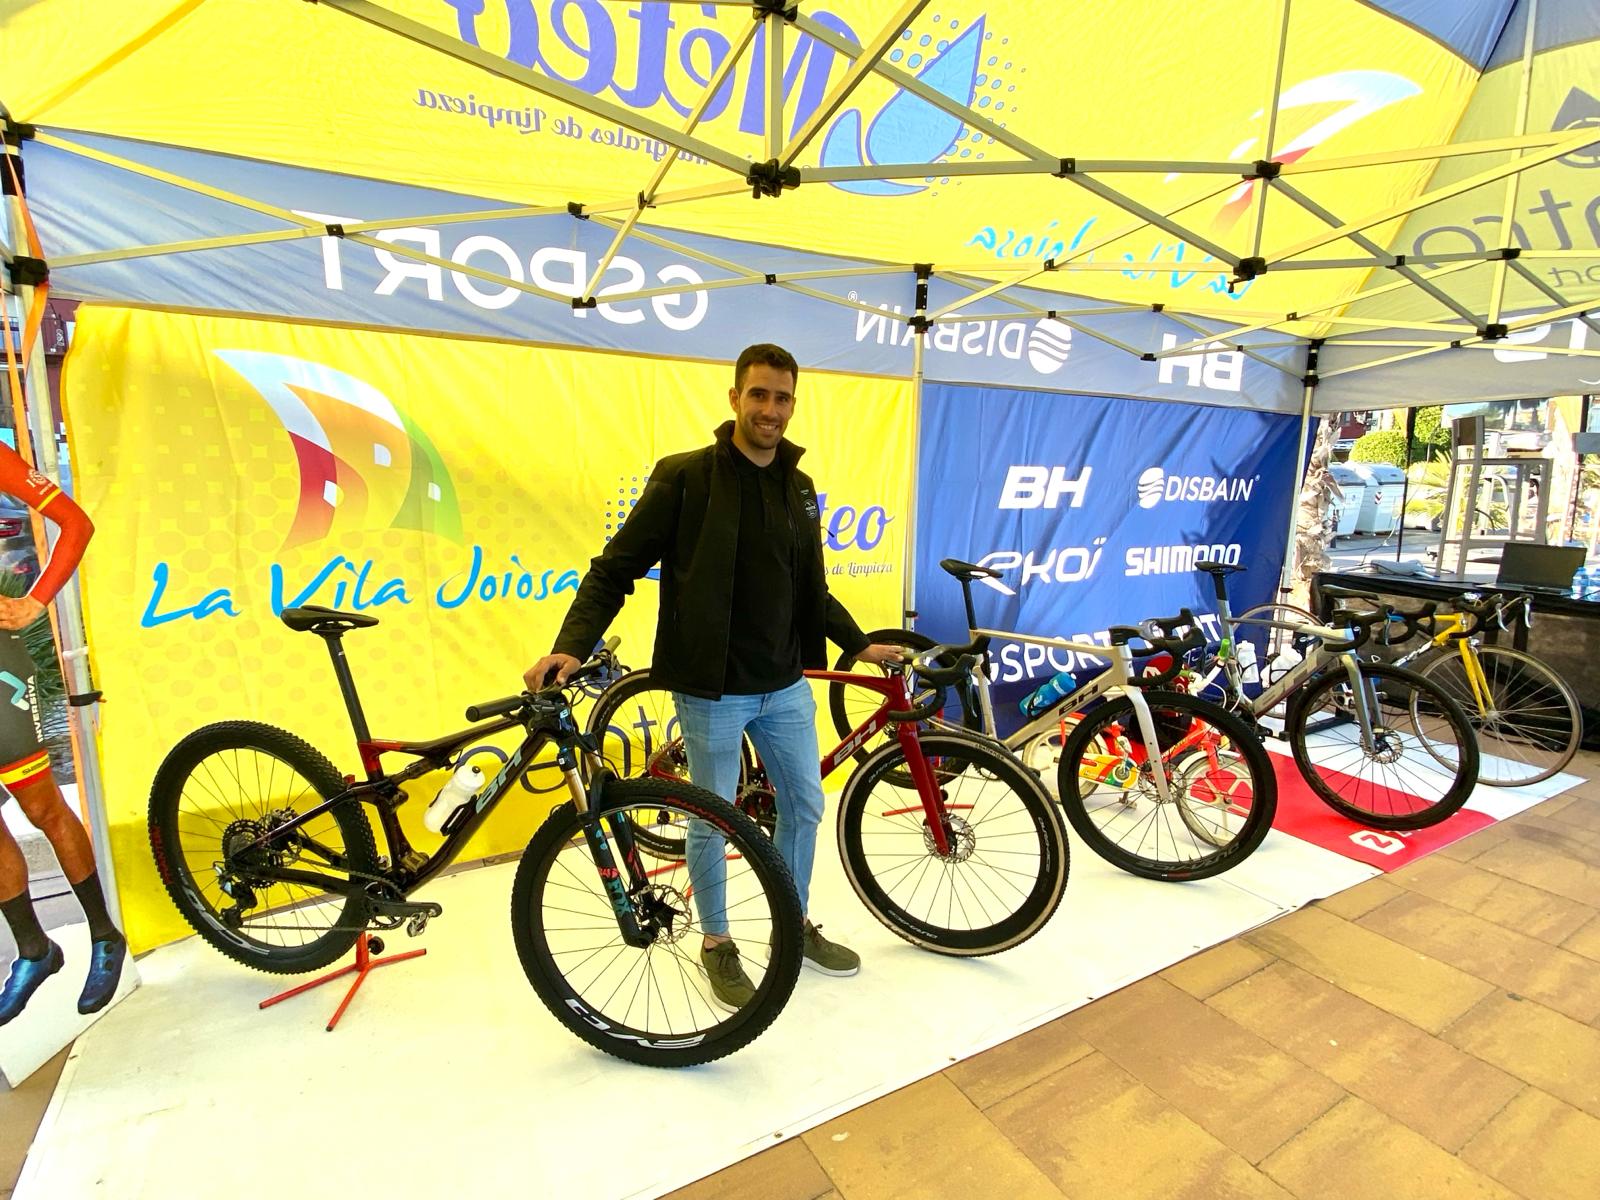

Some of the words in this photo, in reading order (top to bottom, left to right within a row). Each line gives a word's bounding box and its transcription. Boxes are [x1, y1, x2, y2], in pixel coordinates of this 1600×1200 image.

[998, 465, 1092, 510] BH
[141, 562, 244, 628] La
[270, 555, 413, 619] Vila
[1058, 684, 1099, 717] BH
[833, 719, 877, 767] BH
